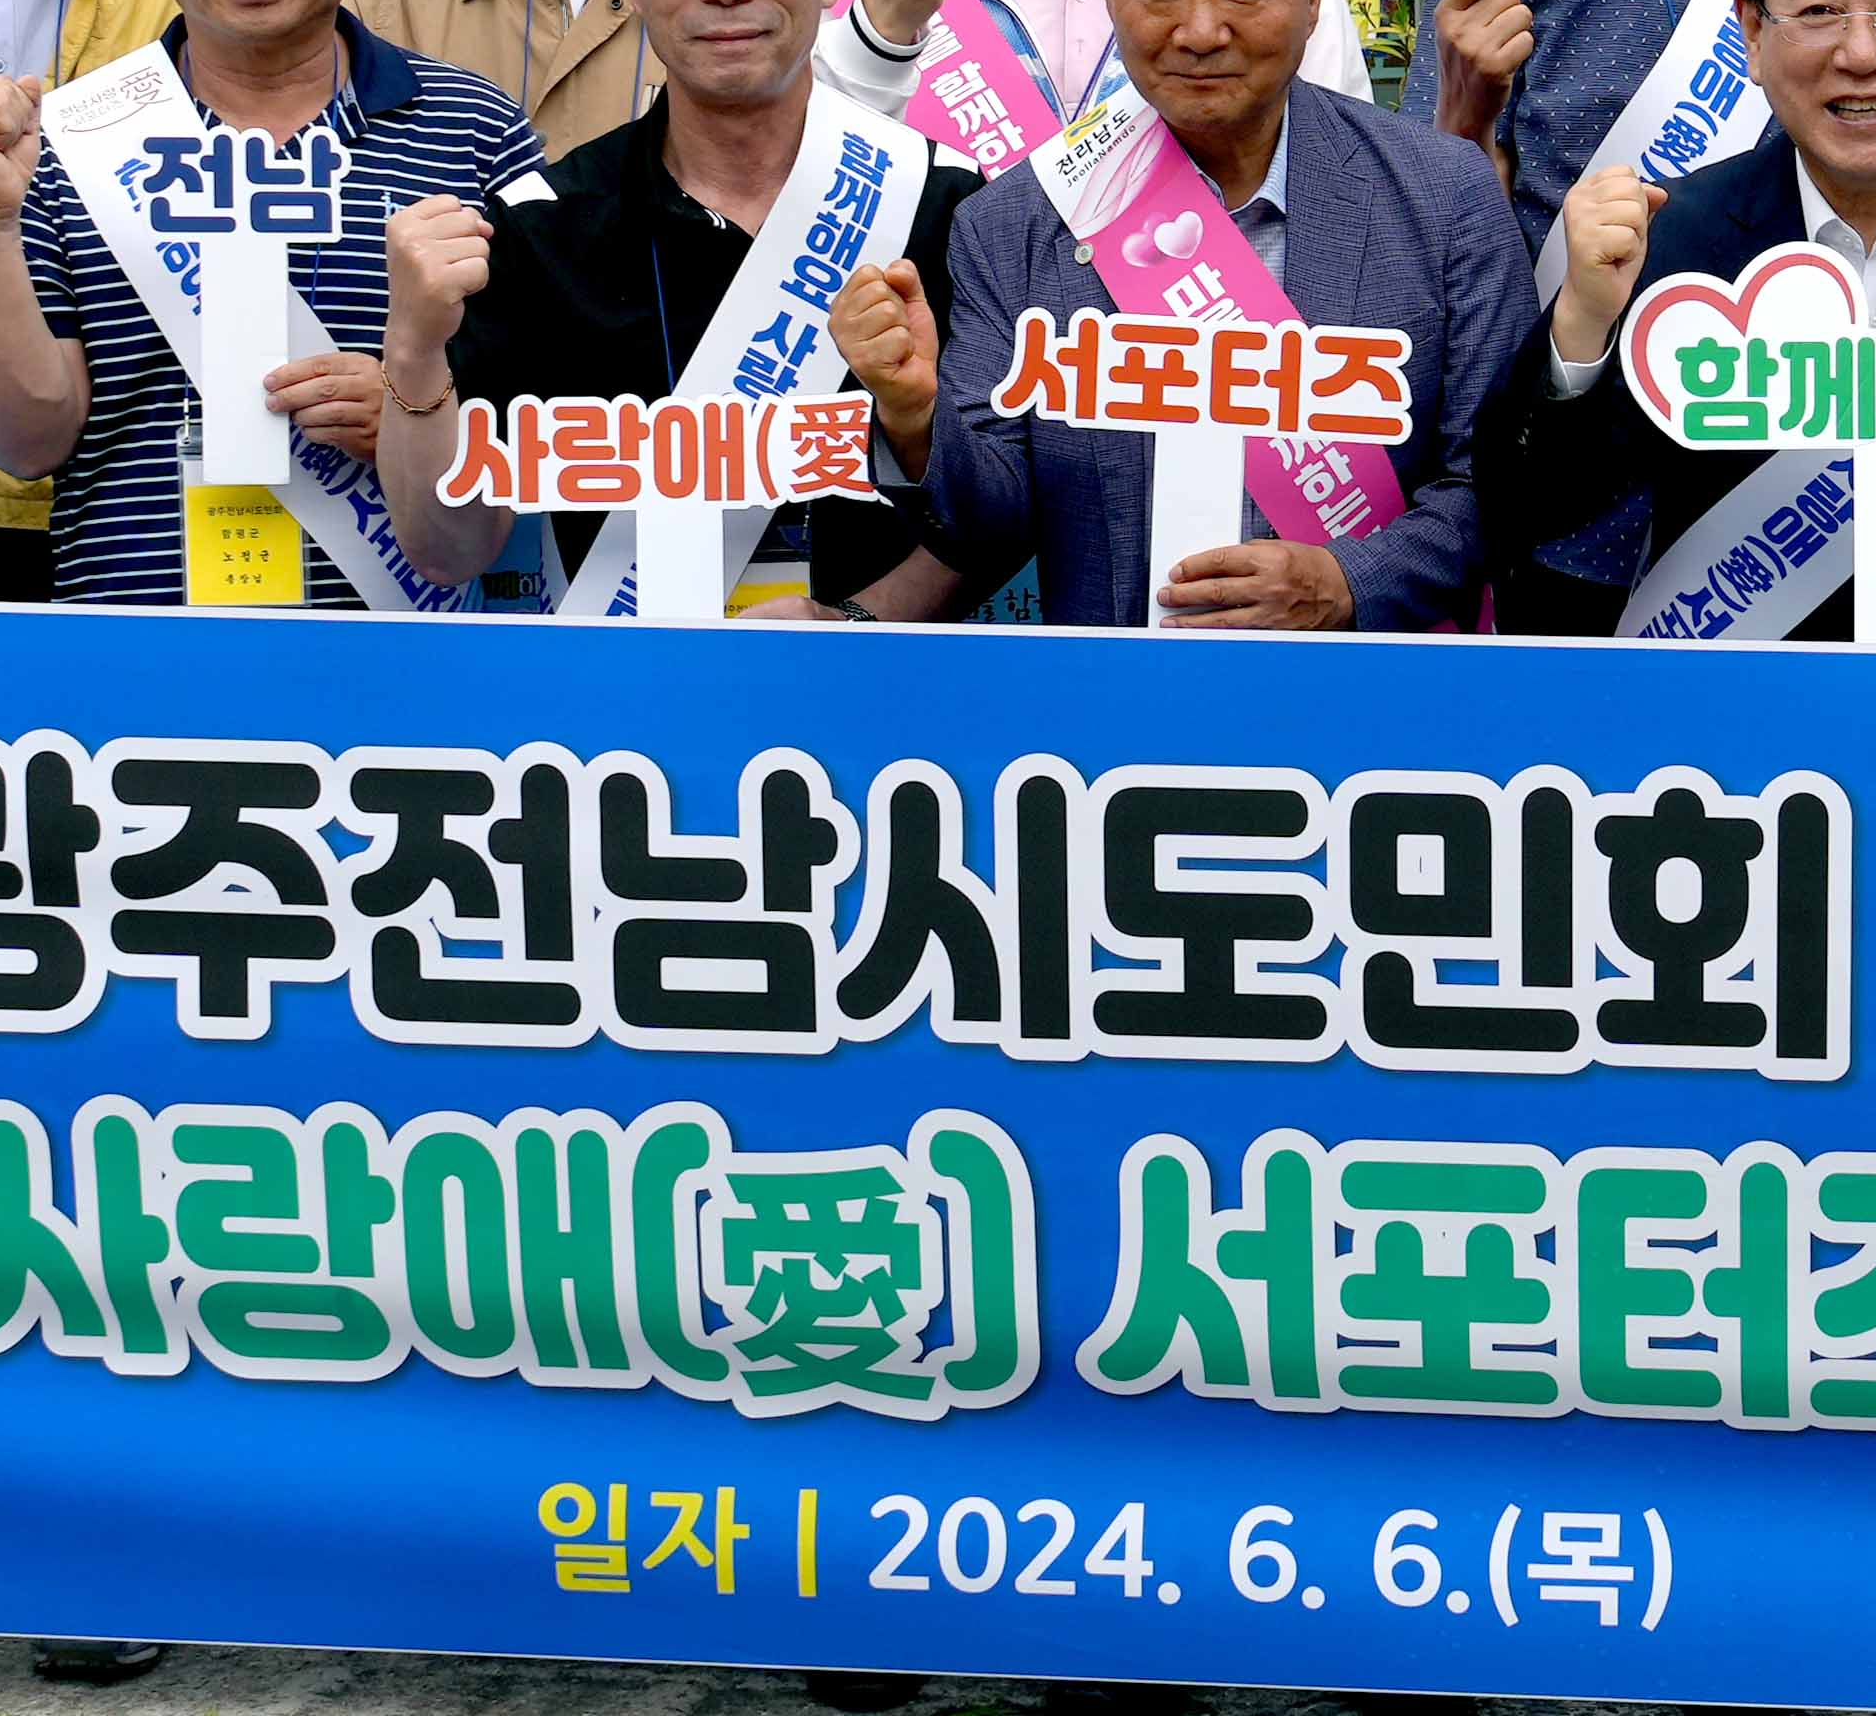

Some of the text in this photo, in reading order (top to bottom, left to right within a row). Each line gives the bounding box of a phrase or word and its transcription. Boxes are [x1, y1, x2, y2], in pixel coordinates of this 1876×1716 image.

[929, 60, 1026, 181] 함께하
[1055, 108, 1131, 176] 전라남도
[1067, 125, 1136, 187] JeollaNamdo
[144, 135, 342, 232] 전남
[780, 129, 893, 312] 함께해요
[999, 317, 1411, 437] 서포터즈
[535, 1486, 750, 1593] 일자
[871, 1494, 1181, 1609] 2024.
[1228, 1507, 1326, 1609] 6.
[1375, 1502, 1674, 1629] 6.(목)
